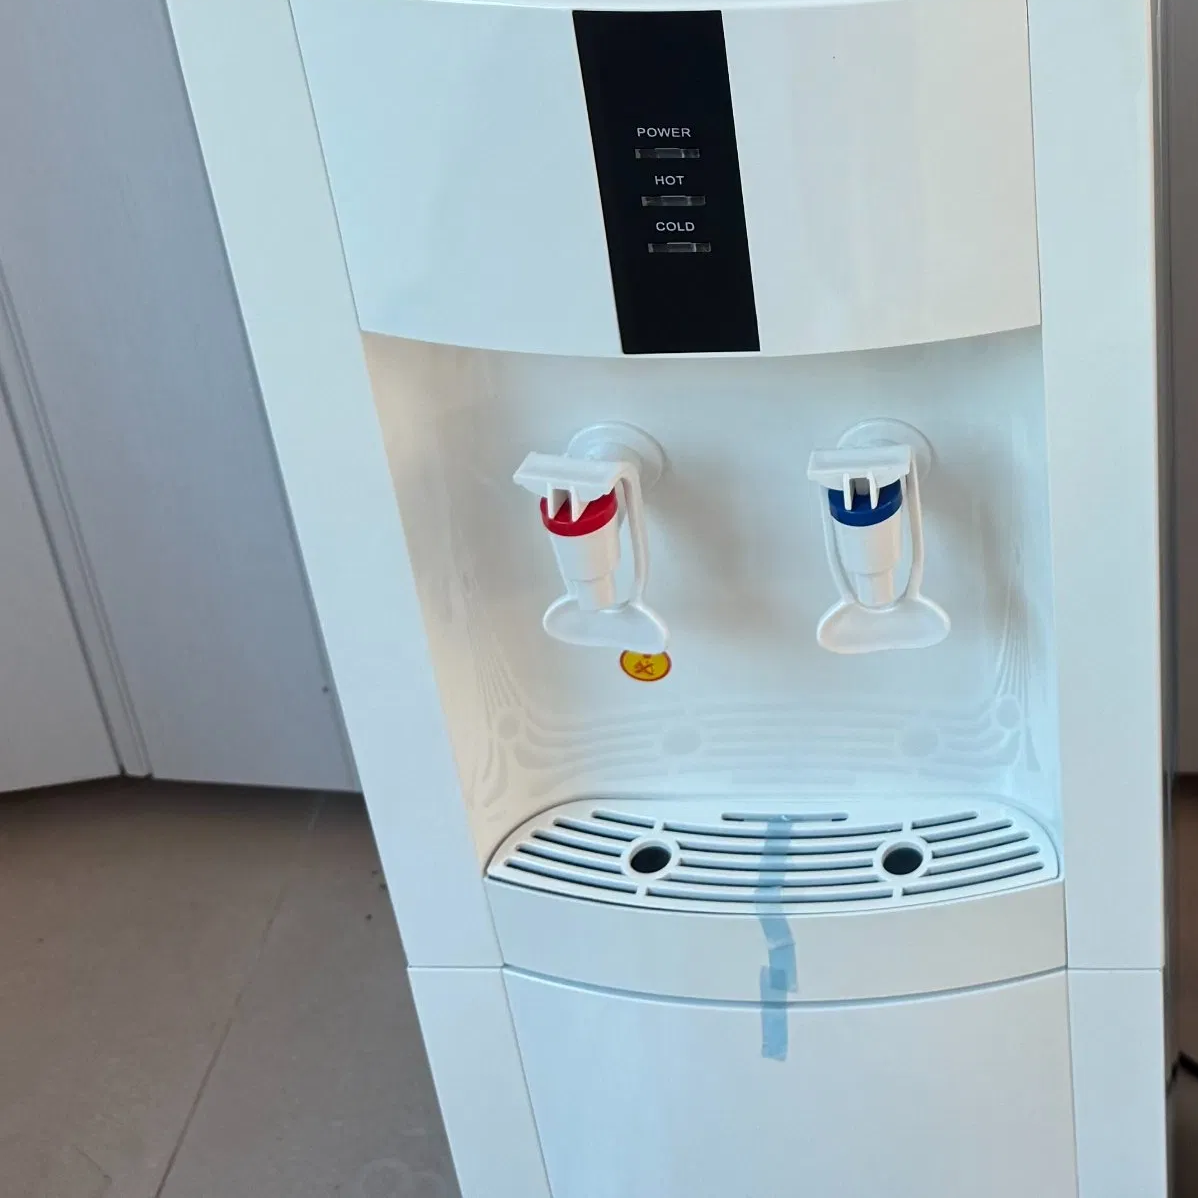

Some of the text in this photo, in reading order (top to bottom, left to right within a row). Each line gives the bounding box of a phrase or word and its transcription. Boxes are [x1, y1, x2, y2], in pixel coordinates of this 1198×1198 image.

[636, 127, 692, 138] POWER
[654, 175, 685, 186] HOT
[655, 221, 695, 232] COLD
